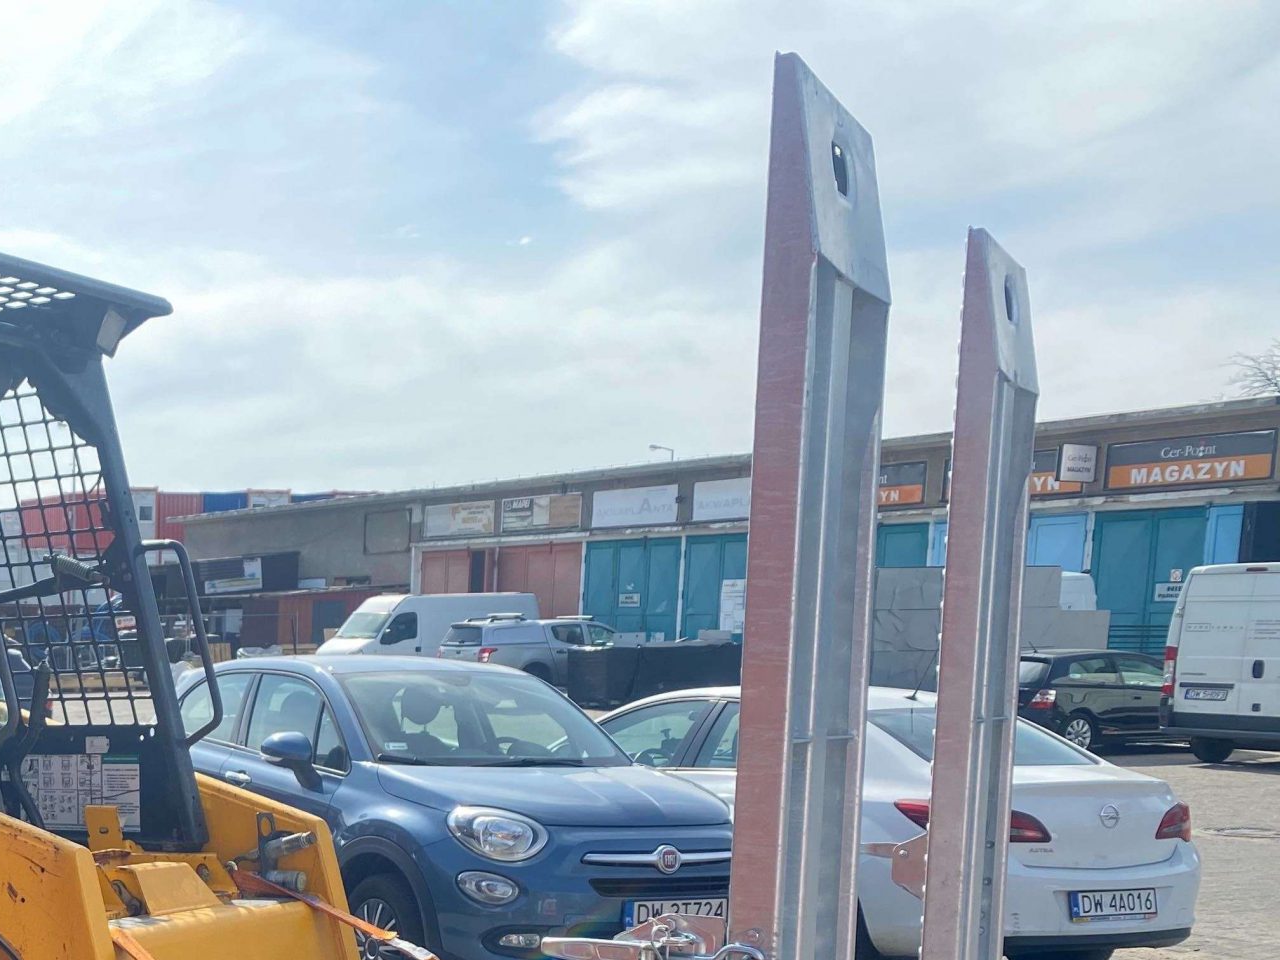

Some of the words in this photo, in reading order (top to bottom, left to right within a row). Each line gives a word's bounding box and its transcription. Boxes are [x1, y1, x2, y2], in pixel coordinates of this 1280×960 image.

[1130, 460, 1246, 485] MAGAZYN
[637, 903, 663, 925] DW
[1081, 894, 1104, 914] DW
[1109, 892, 1153, 912] 4A016
